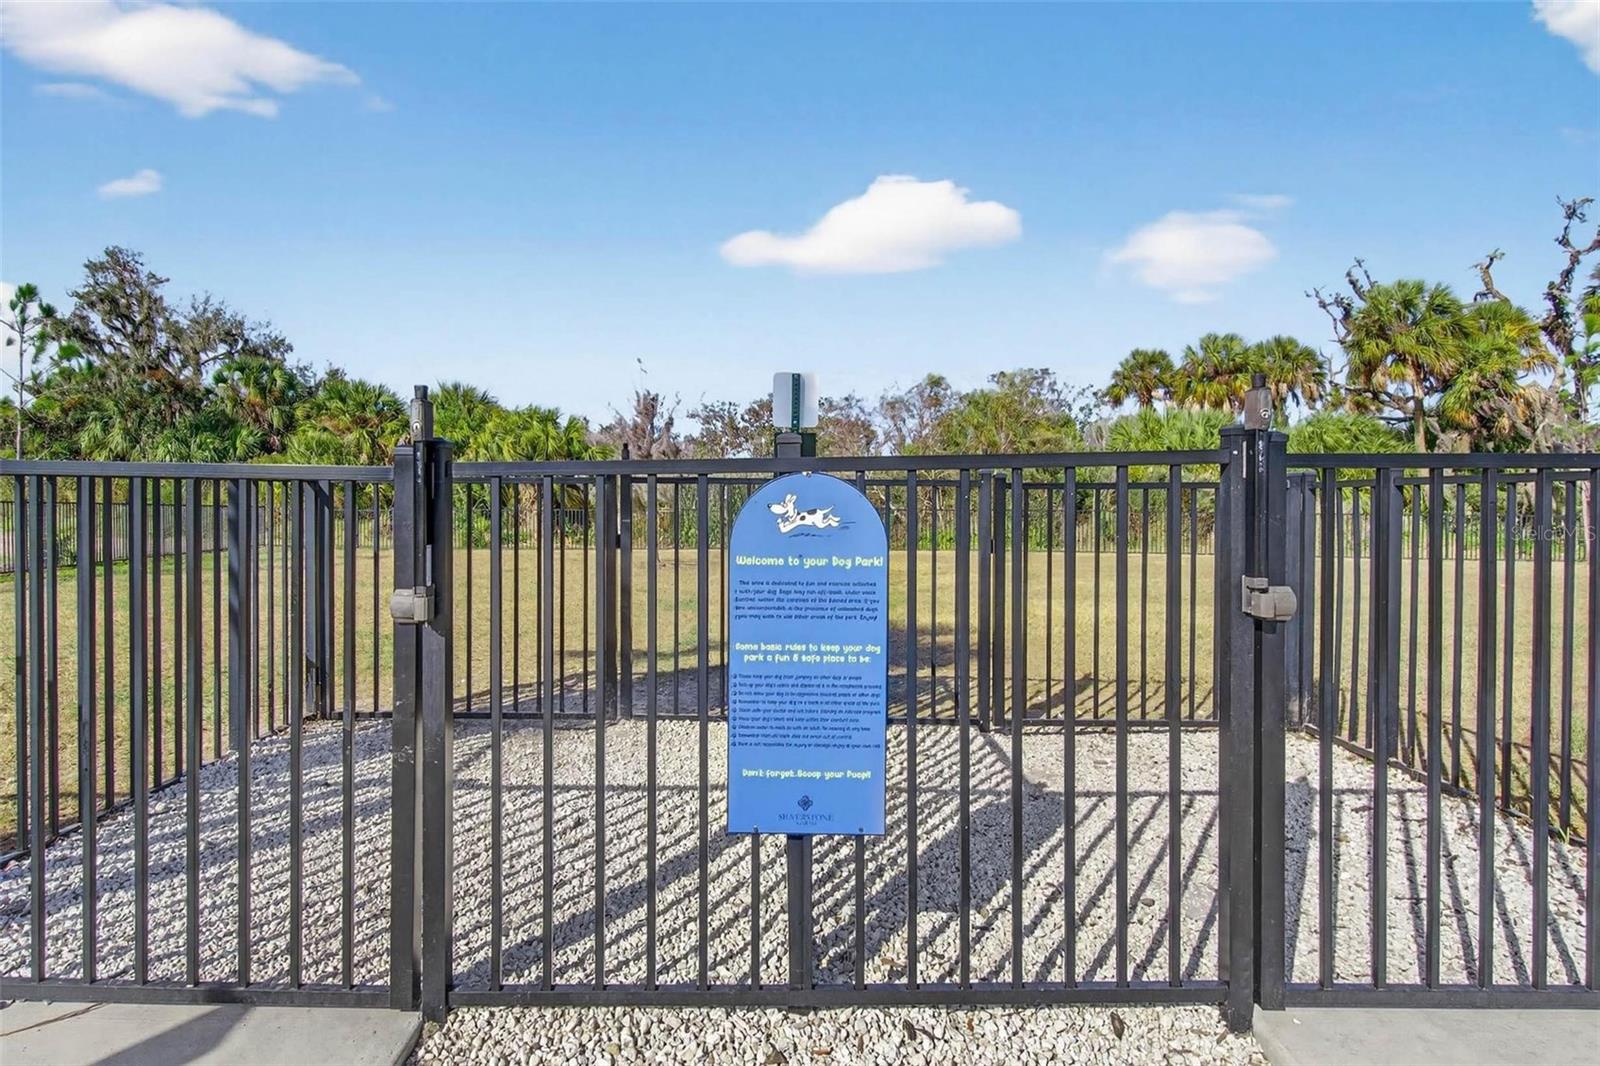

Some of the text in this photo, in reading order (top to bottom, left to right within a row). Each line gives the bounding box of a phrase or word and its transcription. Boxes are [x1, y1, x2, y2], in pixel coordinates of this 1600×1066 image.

[736, 555, 884, 569] Welcome to your Dog Park!
[735, 643, 881, 654] Some basic rules to keep your dog
[743, 653, 764, 663] park
[774, 654, 790, 663] fun
[801, 654, 821, 664] safe
[823, 655, 845, 664] place
[848, 655, 857, 663] to
[742, 768, 764, 777] Don't
[824, 770, 845, 781] your
